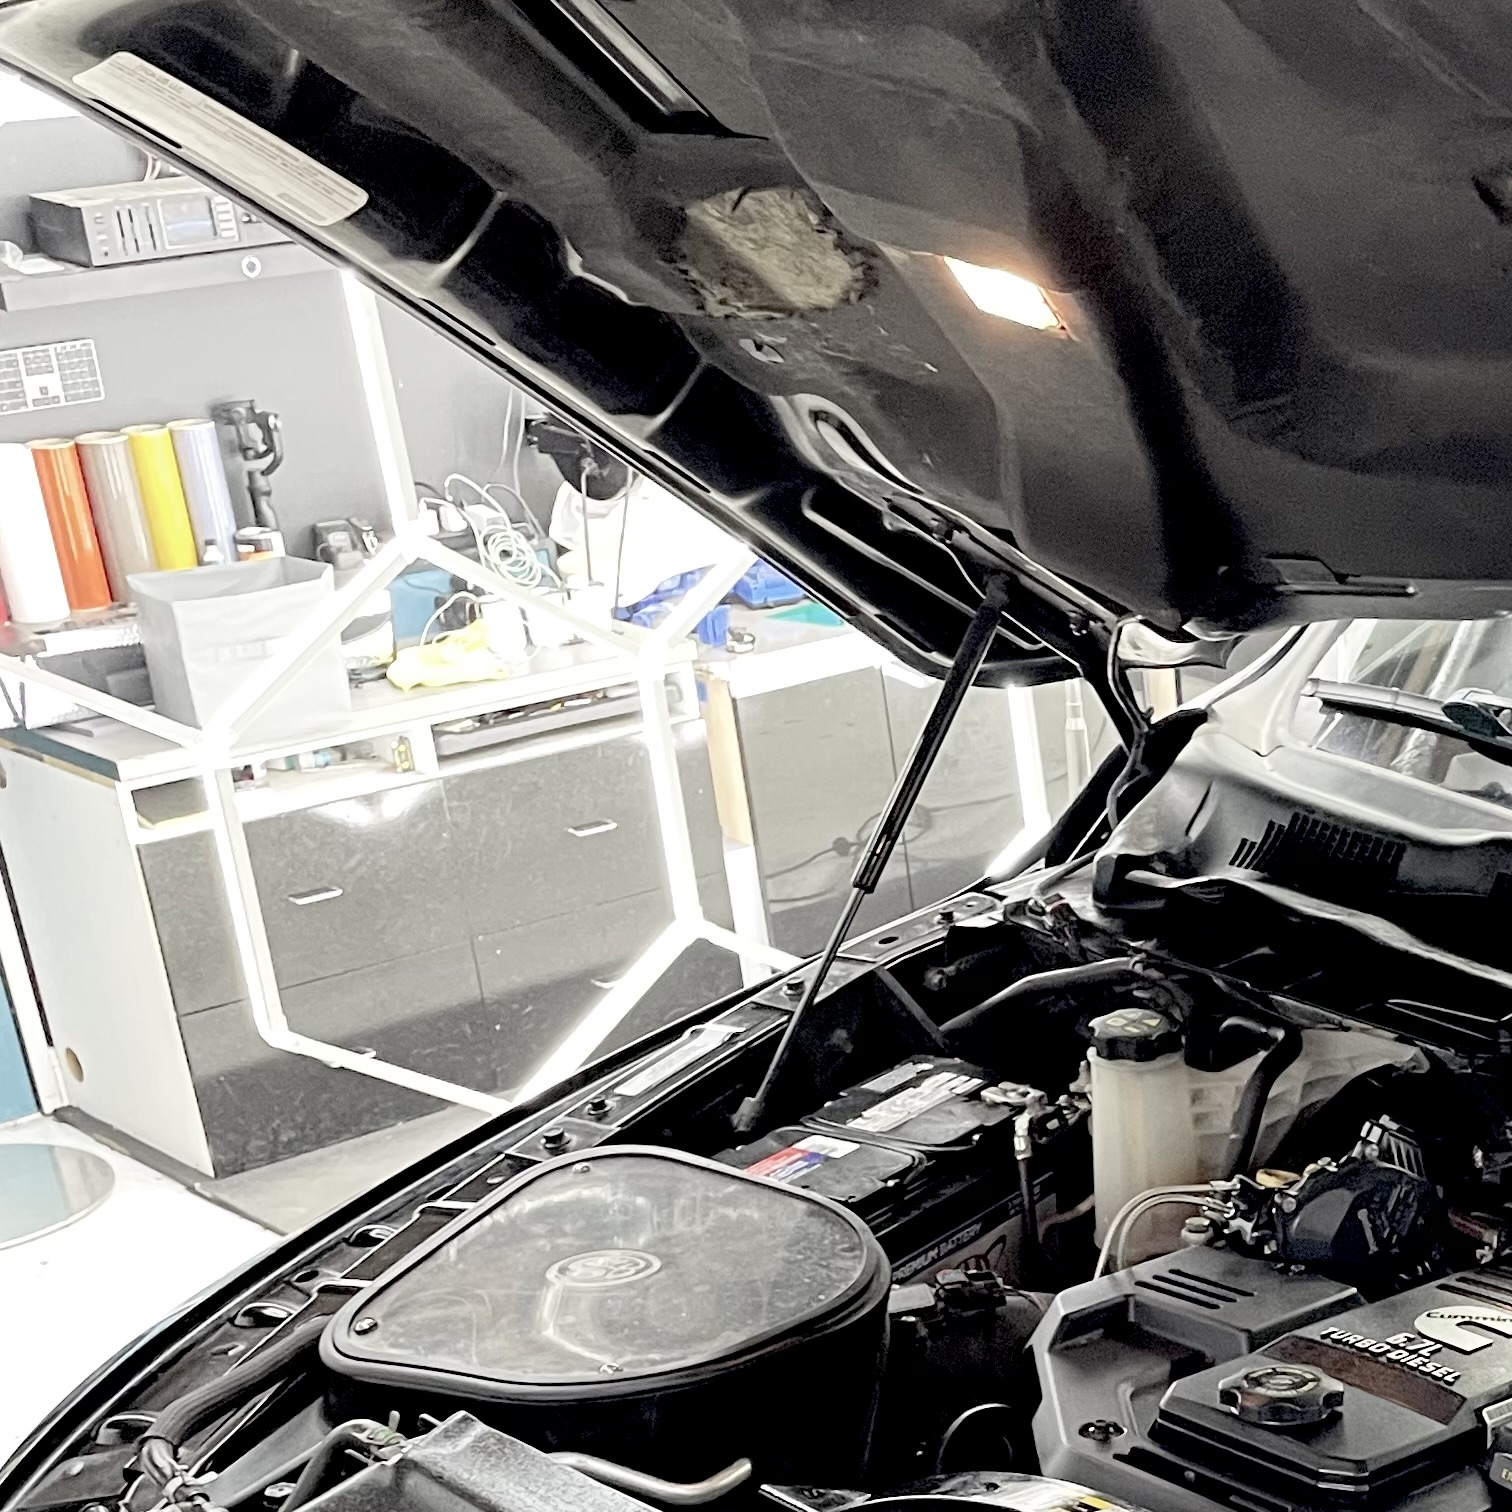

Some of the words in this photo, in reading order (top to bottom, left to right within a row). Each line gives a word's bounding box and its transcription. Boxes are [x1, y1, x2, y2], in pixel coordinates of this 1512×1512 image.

[939, 1222, 982, 1257] BATTERY
[1320, 1326, 1390, 1356] TURBO
[1386, 1345, 1461, 1385] DIESEL
[1386, 1331, 1445, 1357] 6.7L
